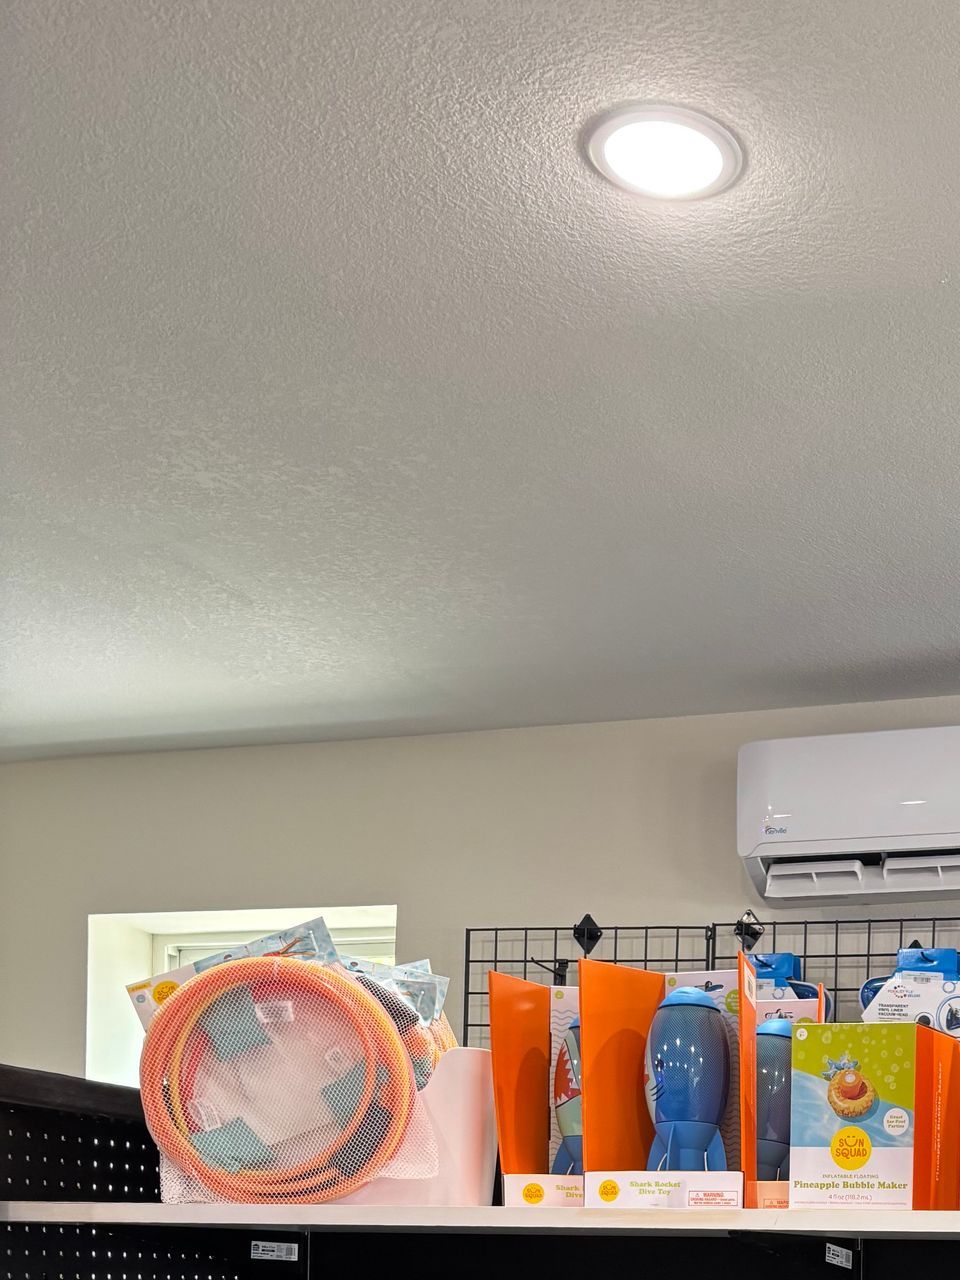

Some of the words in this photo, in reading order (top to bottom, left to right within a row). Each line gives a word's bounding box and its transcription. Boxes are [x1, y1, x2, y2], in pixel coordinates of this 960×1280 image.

[839, 1137, 864, 1148] SUN
[836, 1149, 867, 1159] SQUAD
[793, 1180, 840, 1190] Pineapple
[842, 1181, 875, 1189] Bubble
[878, 1181, 908, 1190] Maker
